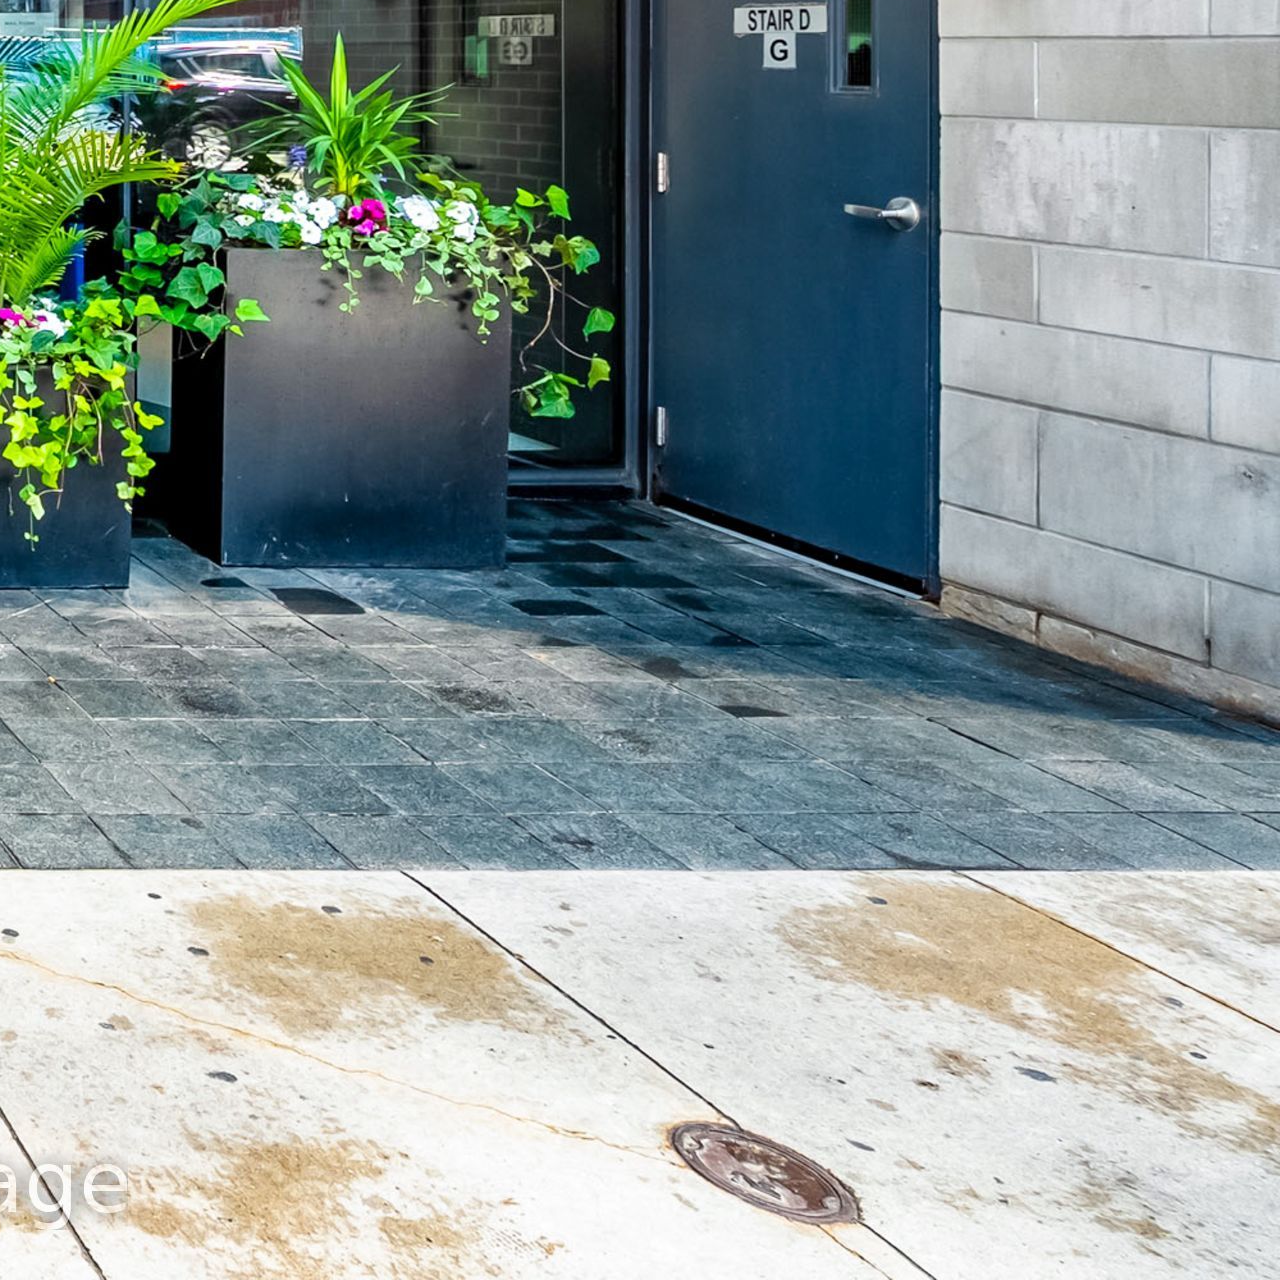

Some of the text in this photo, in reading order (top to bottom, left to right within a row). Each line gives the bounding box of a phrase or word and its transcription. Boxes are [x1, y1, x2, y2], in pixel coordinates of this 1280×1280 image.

[748, 9, 811, 31] STAIR D
[770, 39, 788, 61] G
